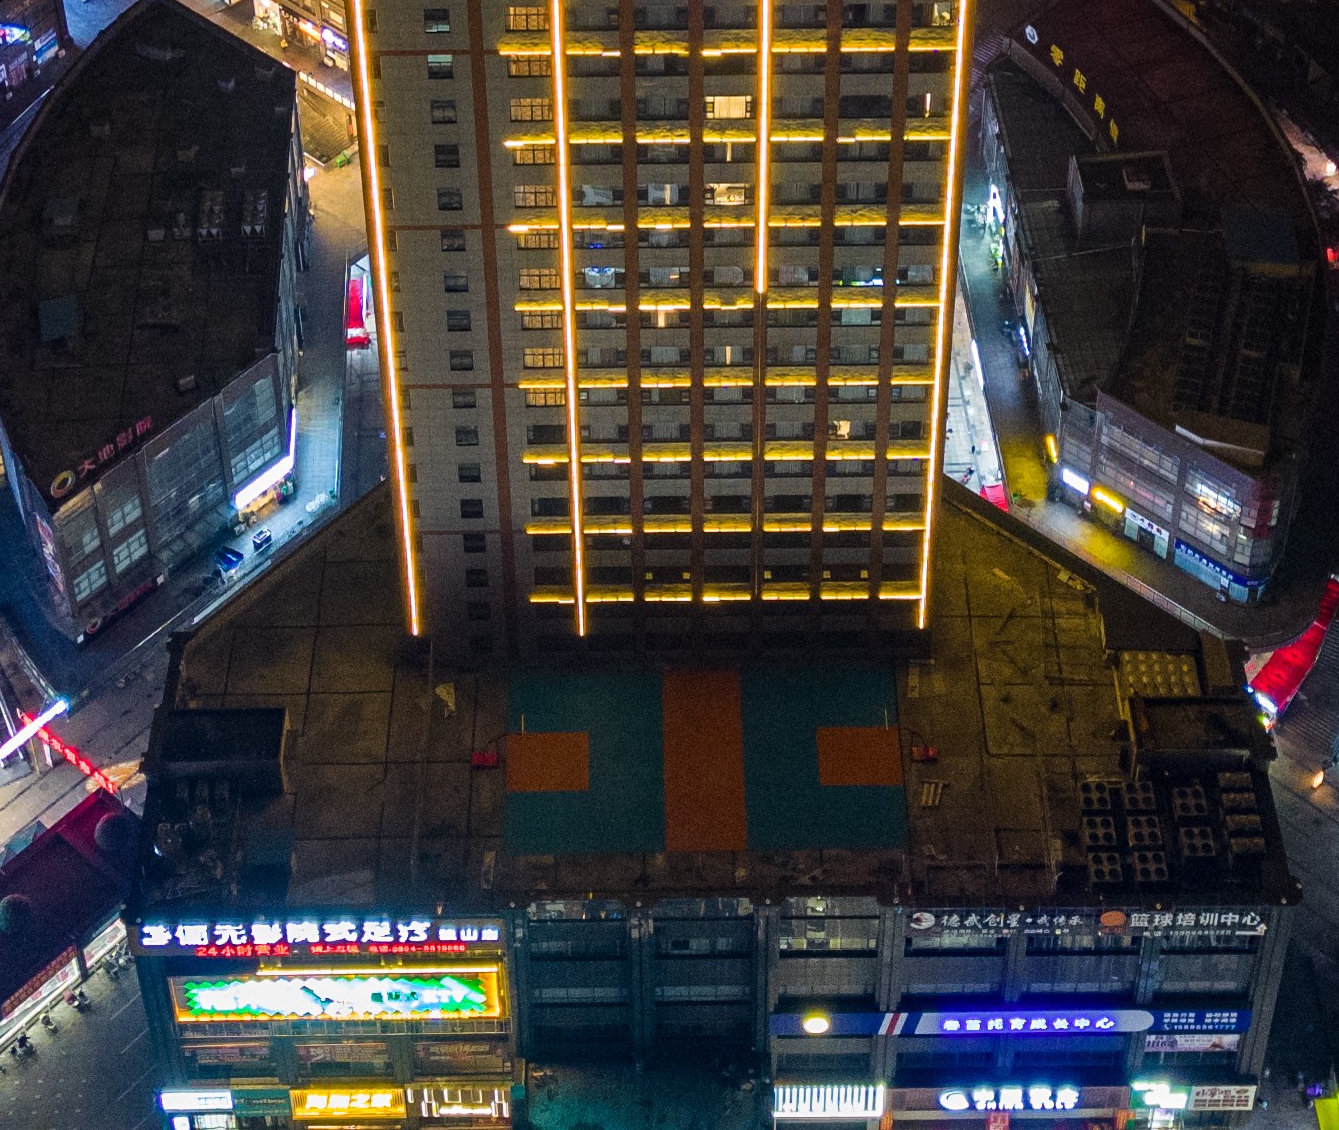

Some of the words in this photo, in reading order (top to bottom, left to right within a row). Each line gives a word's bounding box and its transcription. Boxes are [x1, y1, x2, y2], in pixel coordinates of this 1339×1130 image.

[1129, 912, 1261, 927] 篮球培训中心
